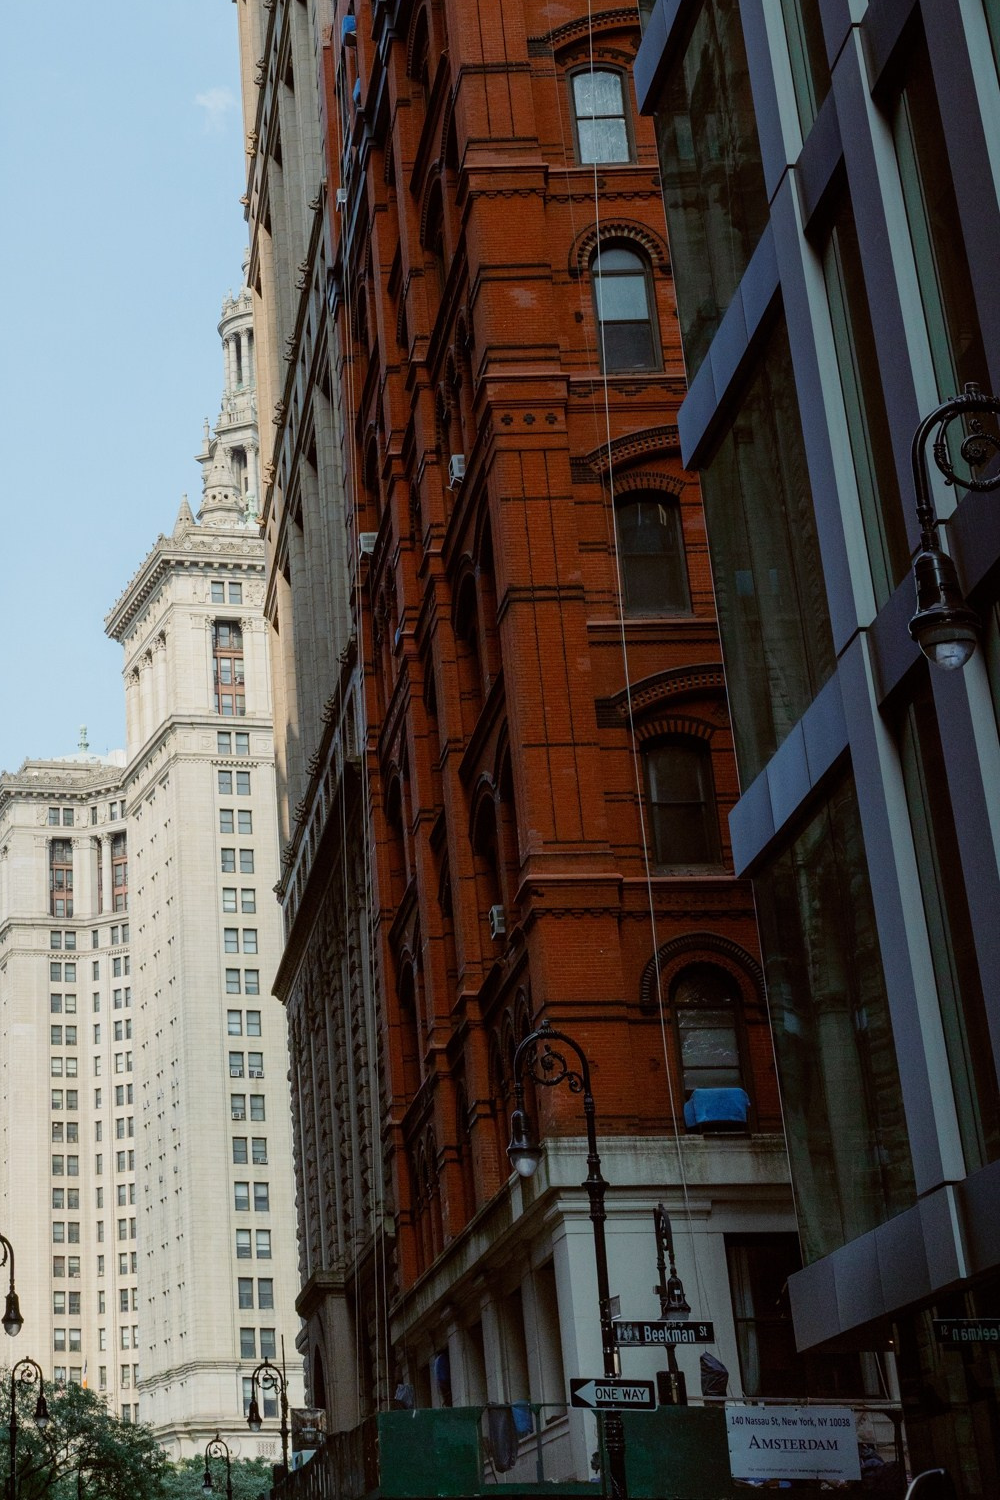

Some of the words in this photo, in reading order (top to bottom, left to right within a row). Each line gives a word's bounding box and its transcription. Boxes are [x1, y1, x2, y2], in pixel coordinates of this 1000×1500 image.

[644, 1325, 696, 1342] Beekman
[699, 1326, 708, 1337] St
[596, 1388, 618, 1400] ONE
[622, 1389, 646, 1401] WAY
[731, 1417, 744, 1425] 140
[745, 1417, 770, 1426] Nassau
[771, 1417, 781, 1427] St,
[782, 1418, 798, 1426] New
[799, 1418, 817, 1427] York,
[818, 1418, 828, 1427] NY
[830, 1418, 851, 1427] 10038
[749, 1435, 838, 1451] AMSTERDAM
